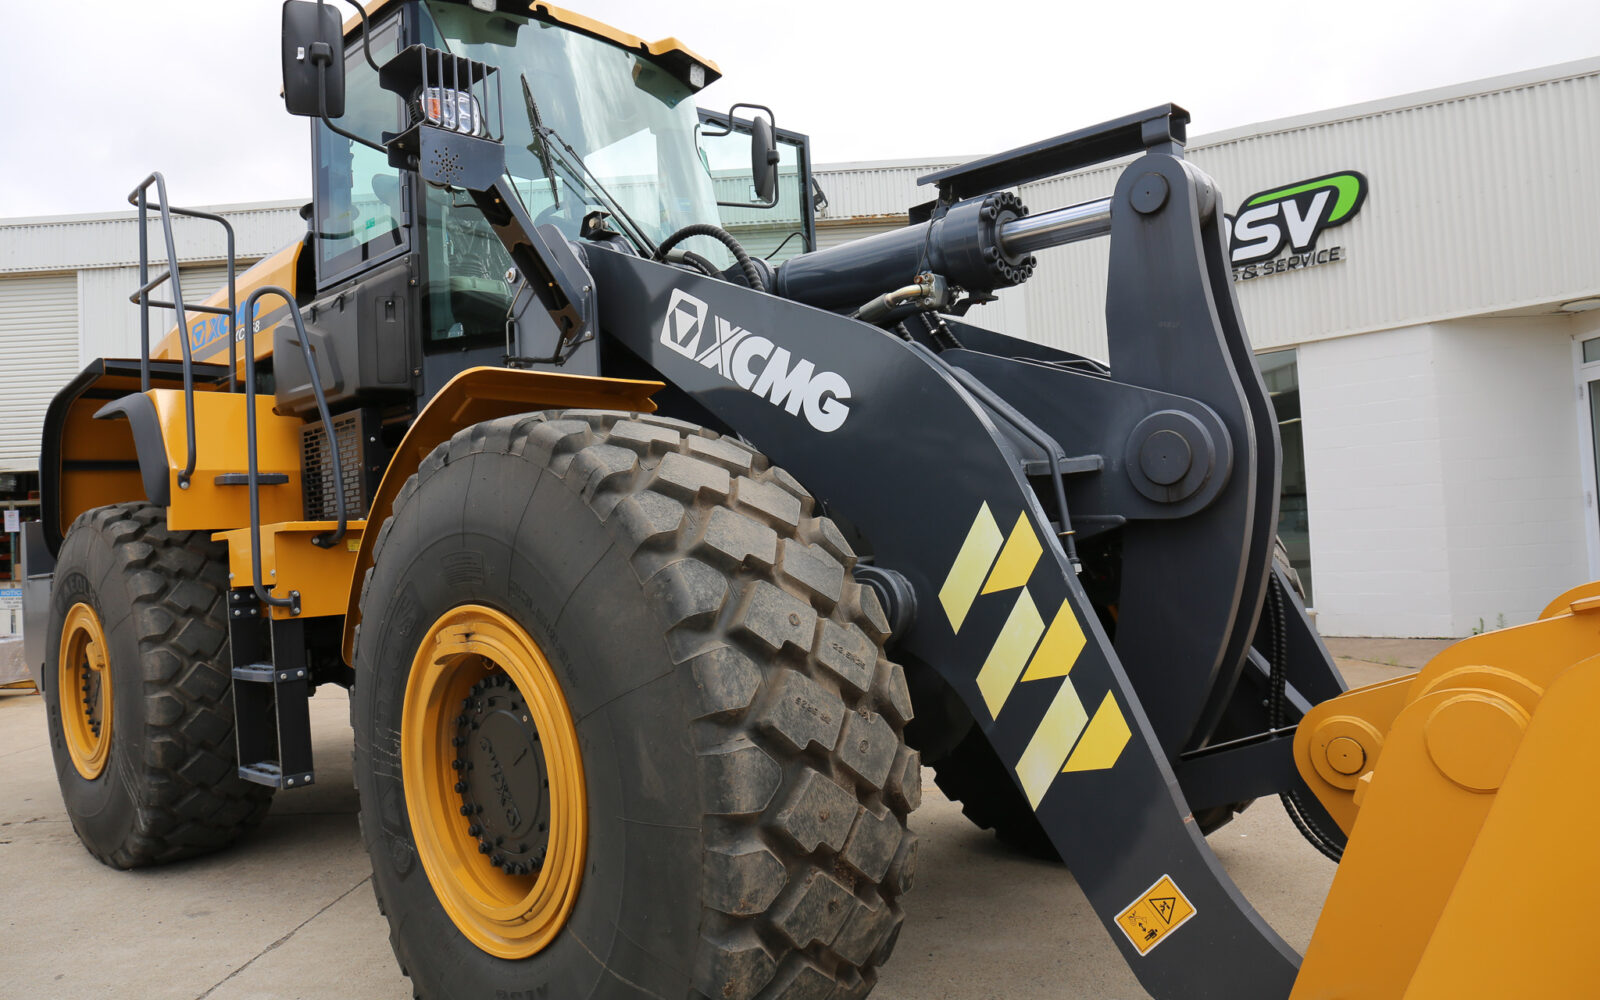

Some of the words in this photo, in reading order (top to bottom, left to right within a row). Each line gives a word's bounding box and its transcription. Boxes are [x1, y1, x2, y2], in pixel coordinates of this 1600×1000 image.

[1225, 190, 1332, 262] SV
[1263, 246, 1340, 275] SERVICE
[694, 315, 852, 433] XCMG
